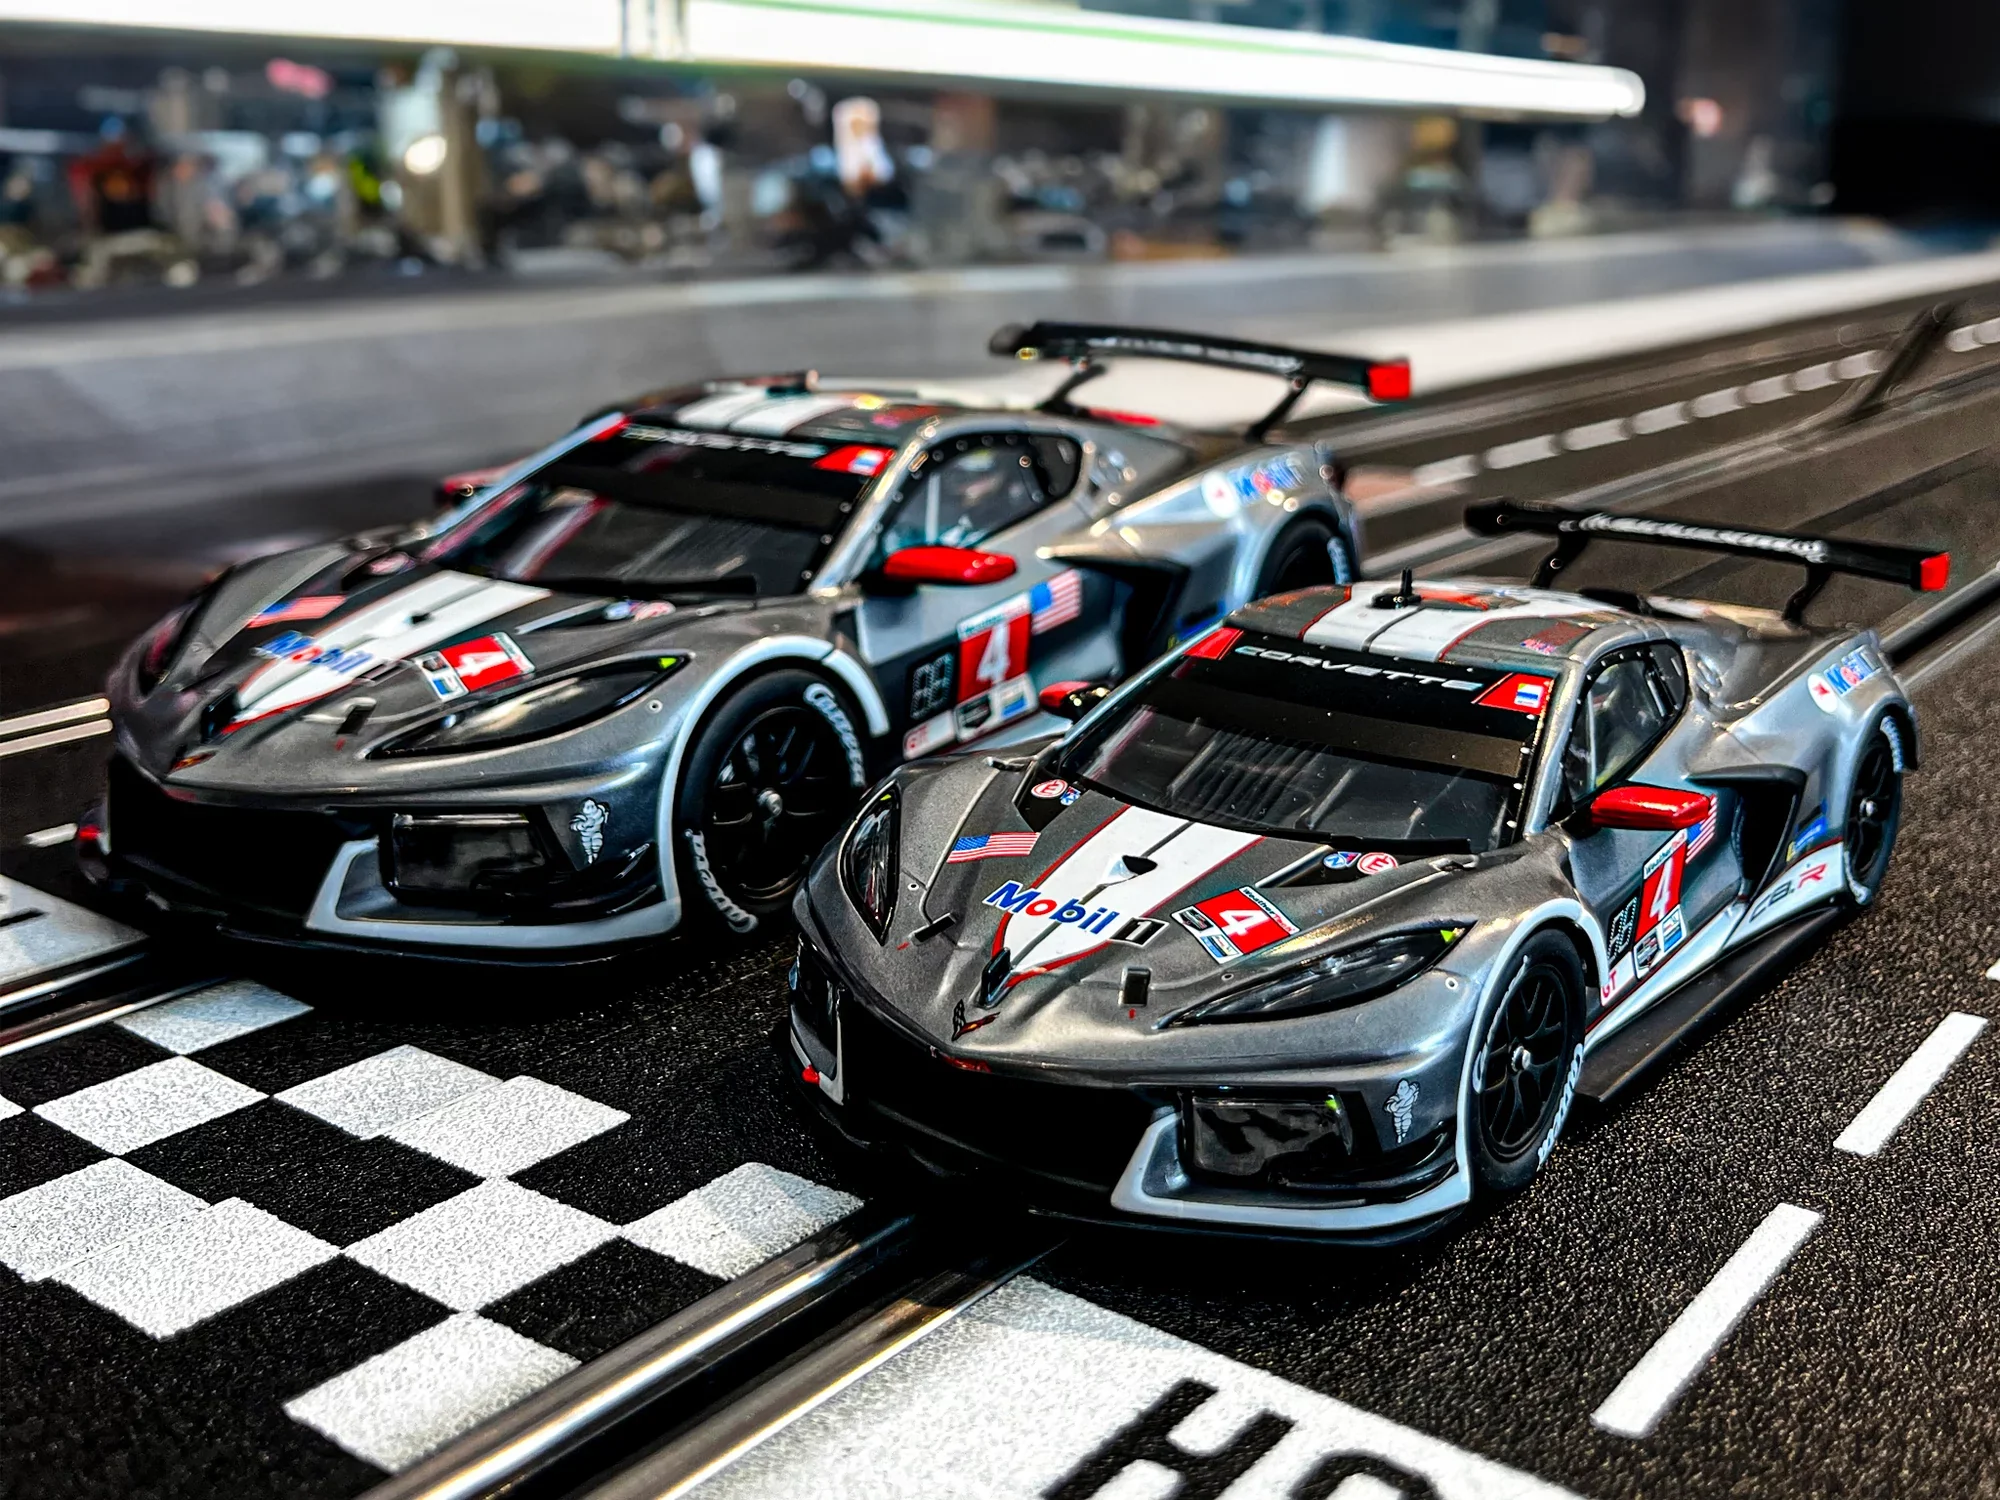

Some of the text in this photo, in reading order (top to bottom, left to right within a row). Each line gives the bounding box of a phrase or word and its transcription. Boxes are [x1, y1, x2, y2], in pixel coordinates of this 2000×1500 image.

[453, 650, 513, 678] 4
[976, 622, 1010, 685] 4
[1234, 644, 1483, 692] CORVETTE
[986, 882, 1121, 935] Mobil
[1649, 856, 1673, 922] 4
[1218, 909, 1271, 937] 4
